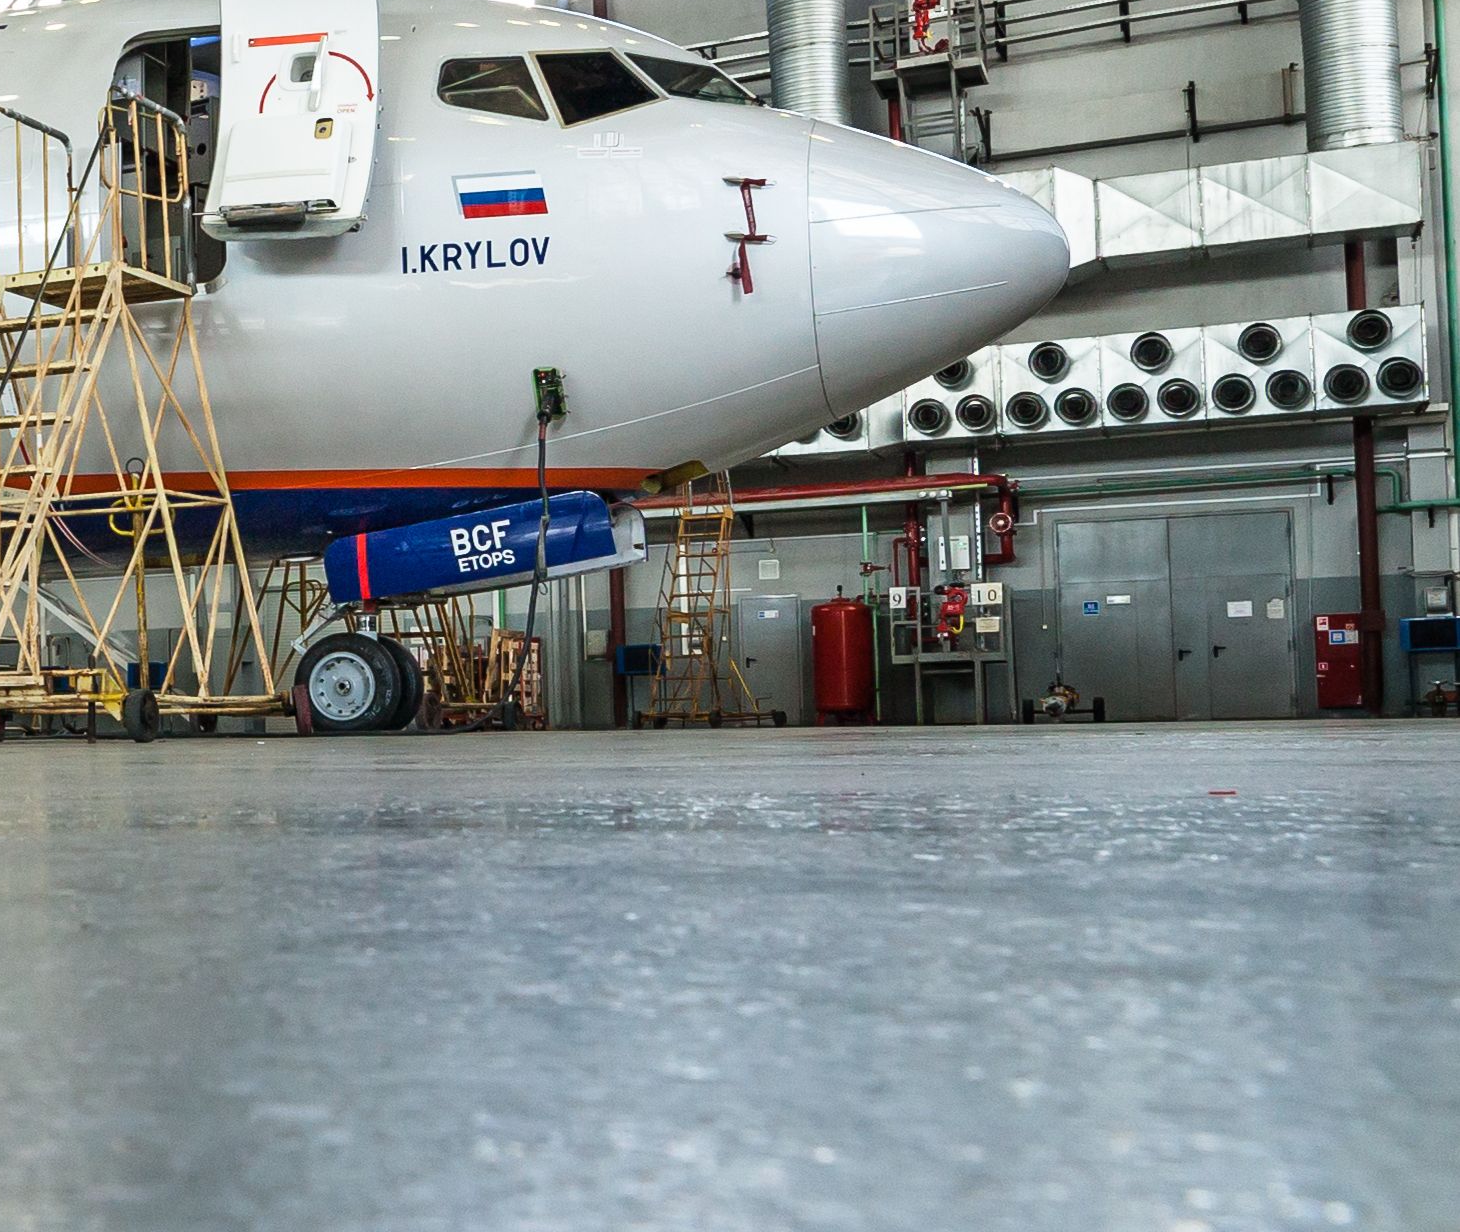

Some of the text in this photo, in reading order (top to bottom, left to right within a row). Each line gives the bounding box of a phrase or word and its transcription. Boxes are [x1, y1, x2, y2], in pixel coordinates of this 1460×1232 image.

[401, 236, 550, 274] I.KRYLOV
[450, 519, 511, 557] BCF
[457, 549, 516, 572] ETOPS
[892, 592, 902, 607] 9
[977, 588, 997, 603] 10
